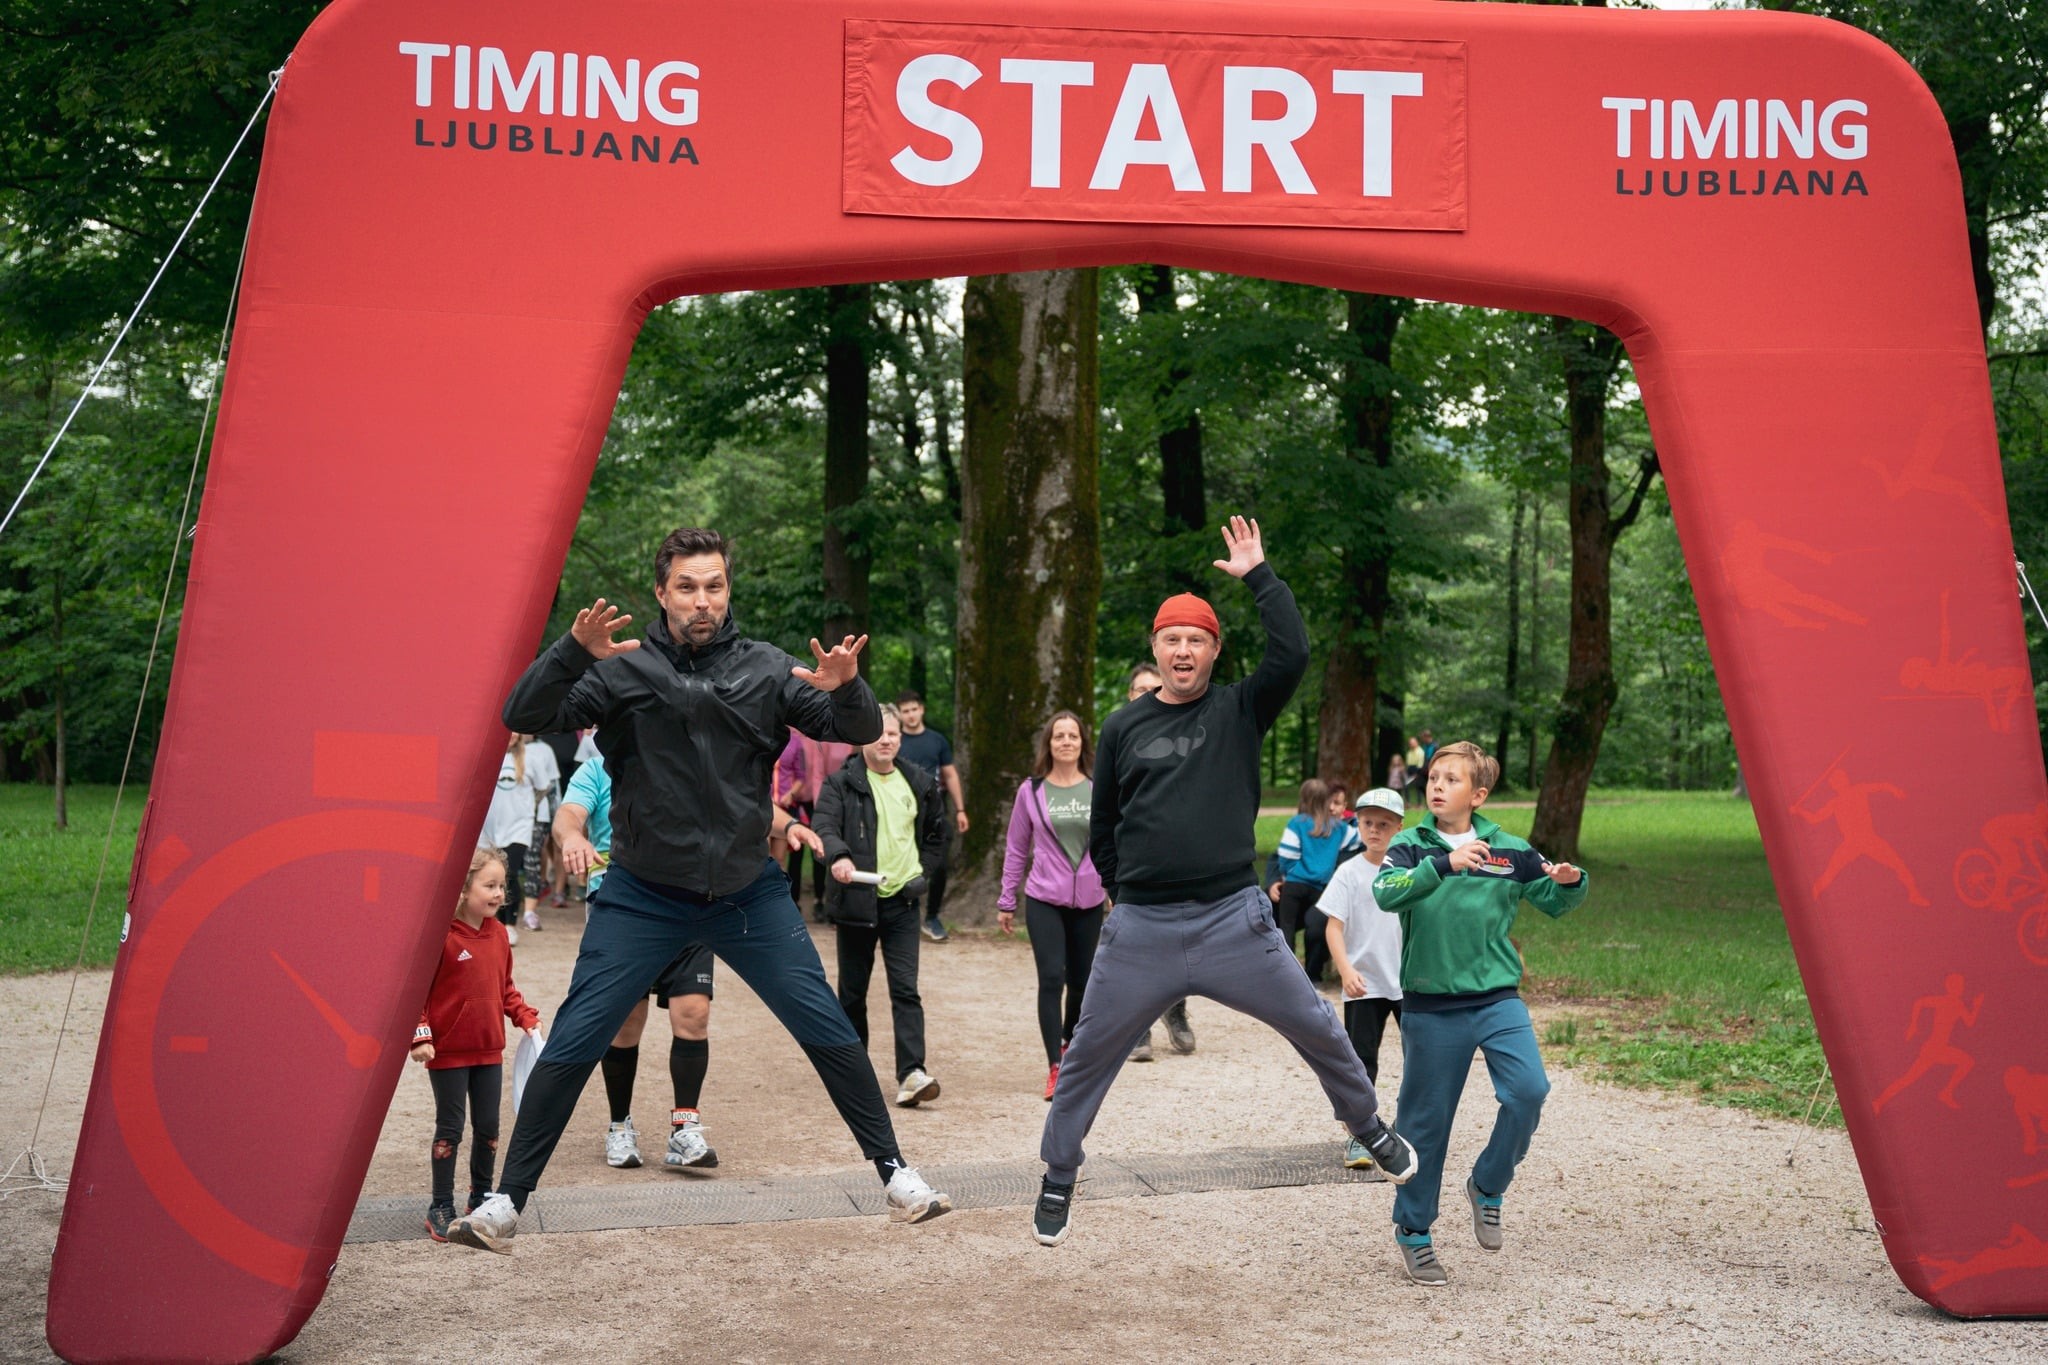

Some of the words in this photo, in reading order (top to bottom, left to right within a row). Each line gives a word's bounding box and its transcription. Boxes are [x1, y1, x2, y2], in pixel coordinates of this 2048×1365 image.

[399, 41, 699, 126] TIMING
[415, 118, 699, 165] LJUBLJANA
[890, 53, 1424, 198] START
[1602, 97, 1868, 160] TIMING
[1616, 168, 1869, 197] LJUBLJANA
